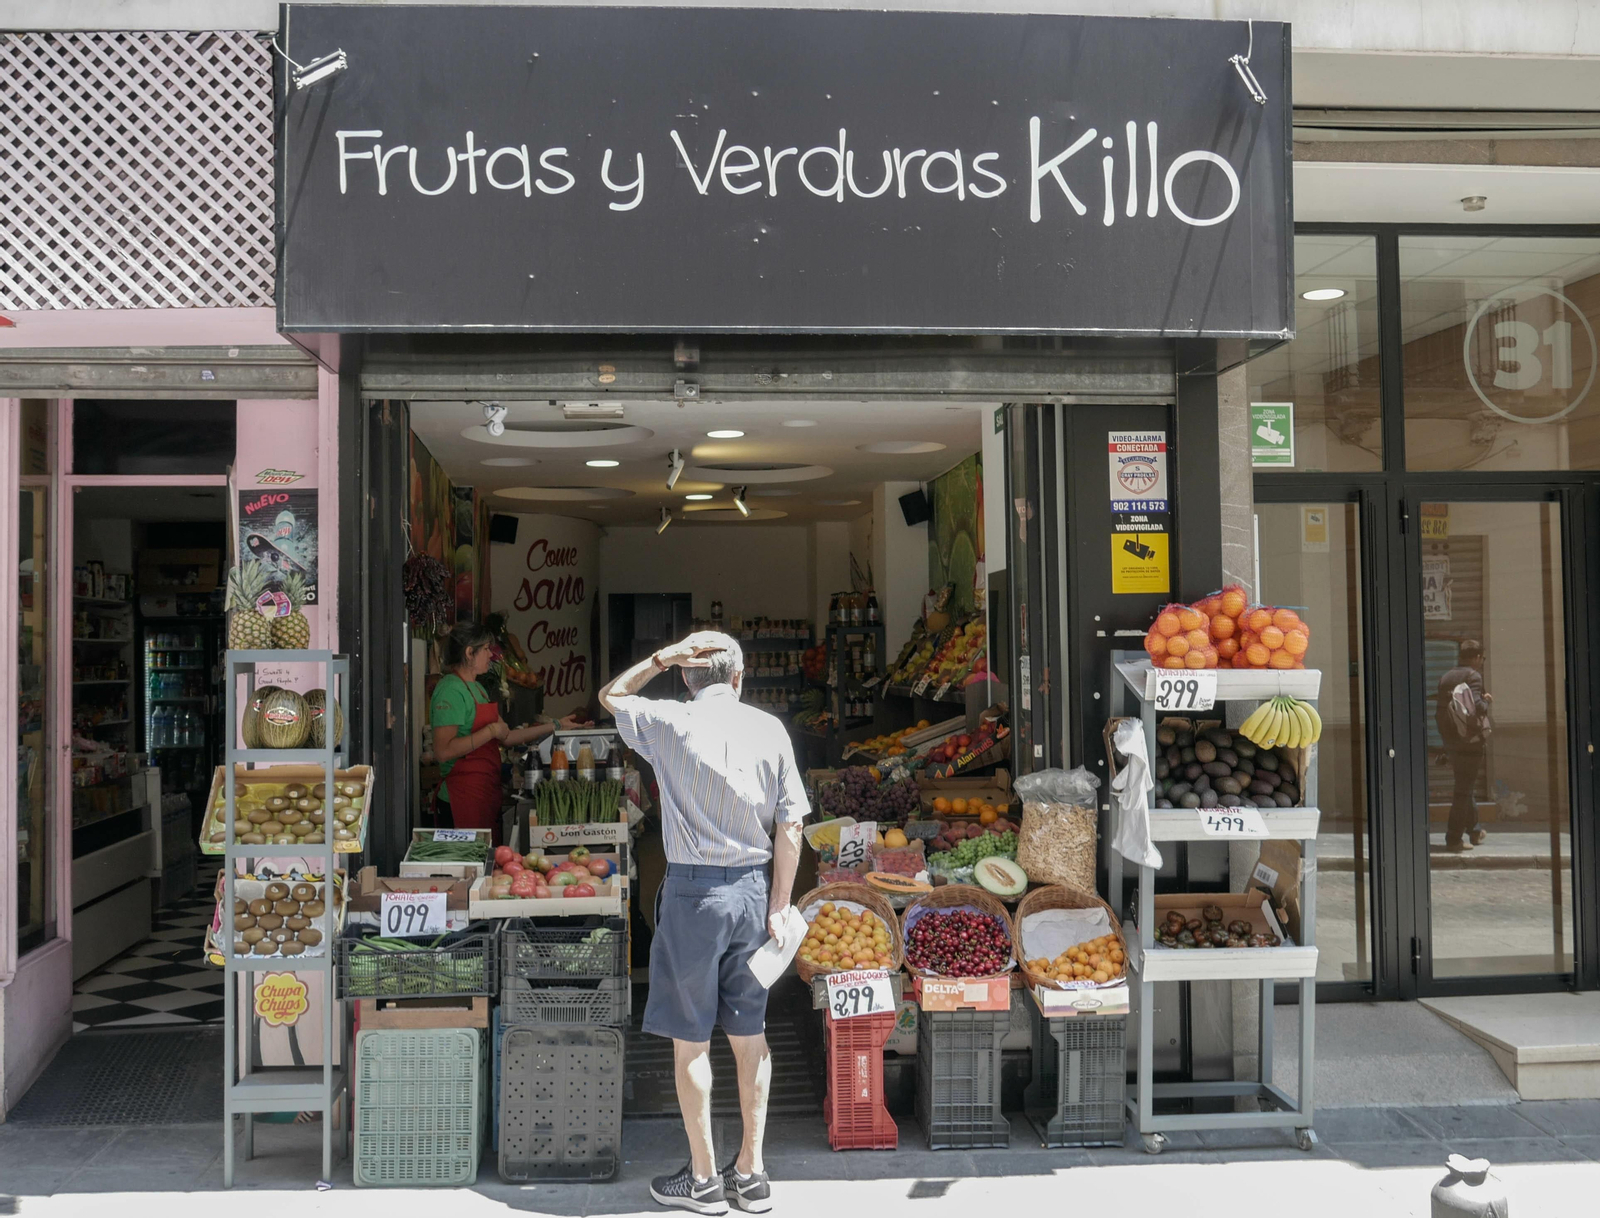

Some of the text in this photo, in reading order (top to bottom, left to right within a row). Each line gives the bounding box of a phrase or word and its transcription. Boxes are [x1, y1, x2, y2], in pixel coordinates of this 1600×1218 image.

[335, 116, 1241, 227] Frutas y Verduras Killo
[1493, 320, 1573, 390] 31
[1116, 444, 1159, 452] CONECTADA
[1113, 502, 1165, 511] 902 114 573
[1130, 515, 1148, 523] ZONA
[526, 539, 579, 572] Come
[513, 574, 586, 612] sano
[526, 620, 579, 654] Come
[260, 985, 303, 1002] Chupa
[924, 983, 959, 995] DELTA
[259, 998, 302, 1018] Chups
